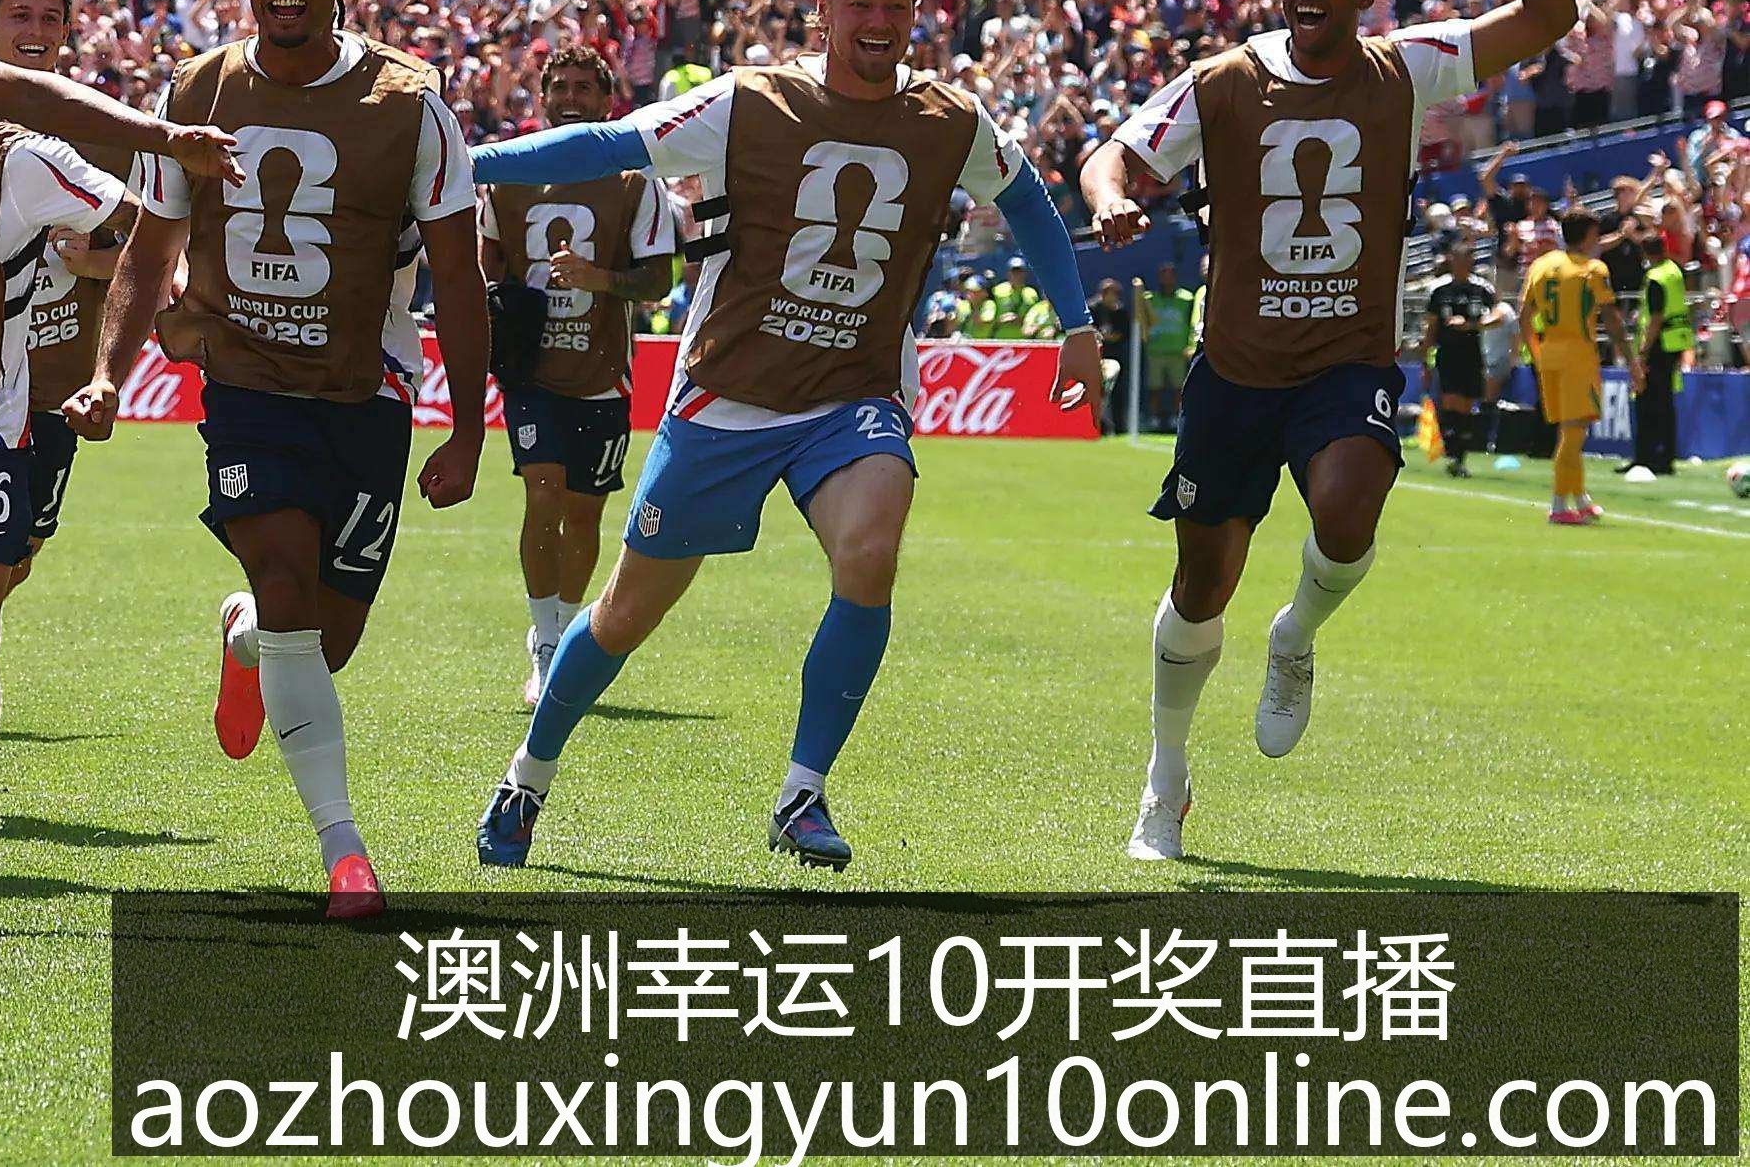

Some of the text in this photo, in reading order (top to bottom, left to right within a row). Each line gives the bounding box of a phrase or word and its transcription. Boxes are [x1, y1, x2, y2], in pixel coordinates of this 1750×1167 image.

[1289, 244, 1336, 261] FIFA
[35, 274, 54, 292] FA
[251, 260, 300, 283] FIFA
[808, 269, 856, 294] FIFA
[1260, 278, 1359, 294] WORLD CUP
[50, 302, 79, 321] CUP
[227, 293, 329, 321] WORLD CUP
[769, 296, 868, 328] WORLD CUP
[1258, 294, 1359, 320] 2026
[1543, 278, 1559, 327] 5
[27, 318, 80, 351] 026
[566, 321, 591, 333] CUP
[758, 314, 859, 350] 2026
[540, 333, 590, 352] 026
[1374, 388, 1392, 419] 6
[596, 433, 627, 475] 10
[221, 465, 246, 481] USA
[334, 491, 395, 562] 12
